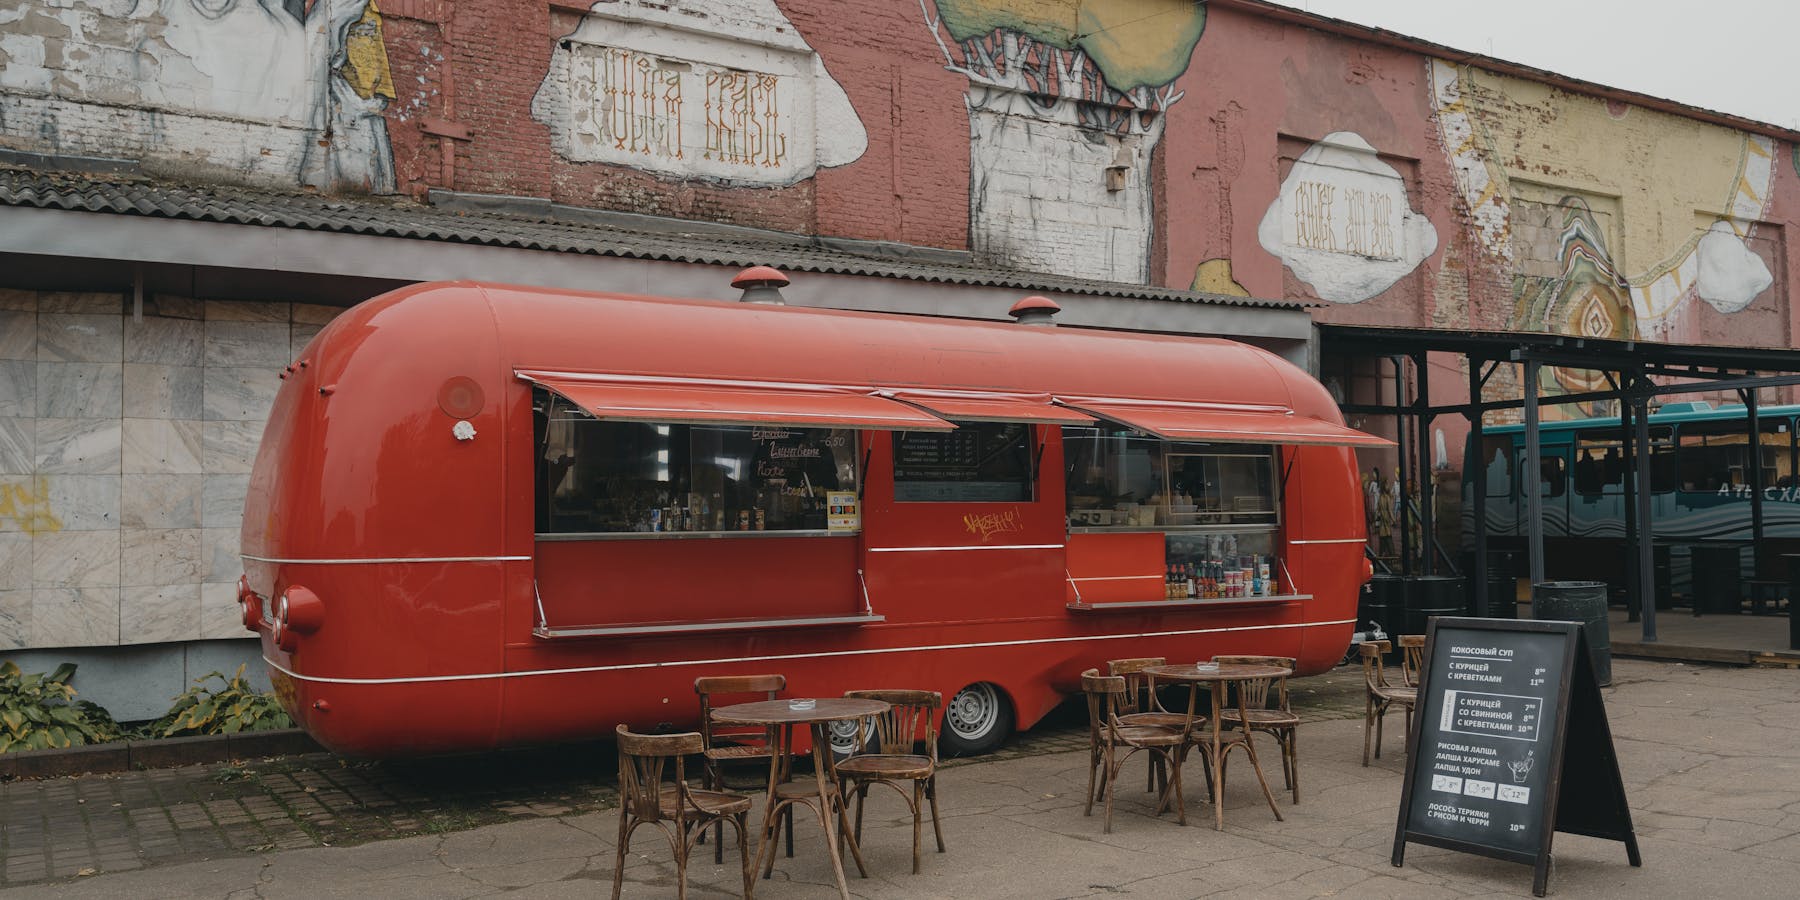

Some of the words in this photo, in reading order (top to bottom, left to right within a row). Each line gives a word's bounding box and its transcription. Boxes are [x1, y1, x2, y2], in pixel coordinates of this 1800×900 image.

[1451, 646, 1497, 656] КОКОСОВЫЙ
[1498, 649, 1514, 657] СУП
[1455, 663, 1489, 672] КУРИЦЕЙ
[1454, 673, 1502, 683] КРЕВЕТКАМИ
[1466, 699, 1501, 708] КУРИЦЕЙ
[1458, 708, 1470, 716] СО
[1470, 709, 1513, 720] СВИНИНОЙ
[1463, 720, 1513, 731] КРЕВЕТКАМИ
[1437, 742, 1469, 752] РИСОВАЯ
[1470, 746, 1497, 756] ЛАПША
[1435, 753, 1462, 762] ЛАПША
[1463, 757, 1500, 767] ХАРУСАМЕ
[1434, 763, 1460, 772] ЛАПША
[1461, 767, 1481, 775] УДОН
[1428, 803, 1457, 814] ЛОСОСЬ
[1457, 807, 1490, 819] ТЕРИЯКИ
[1433, 811, 1459, 822] РИСОМ
[1466, 817, 1490, 827] ЧЕРРИ
